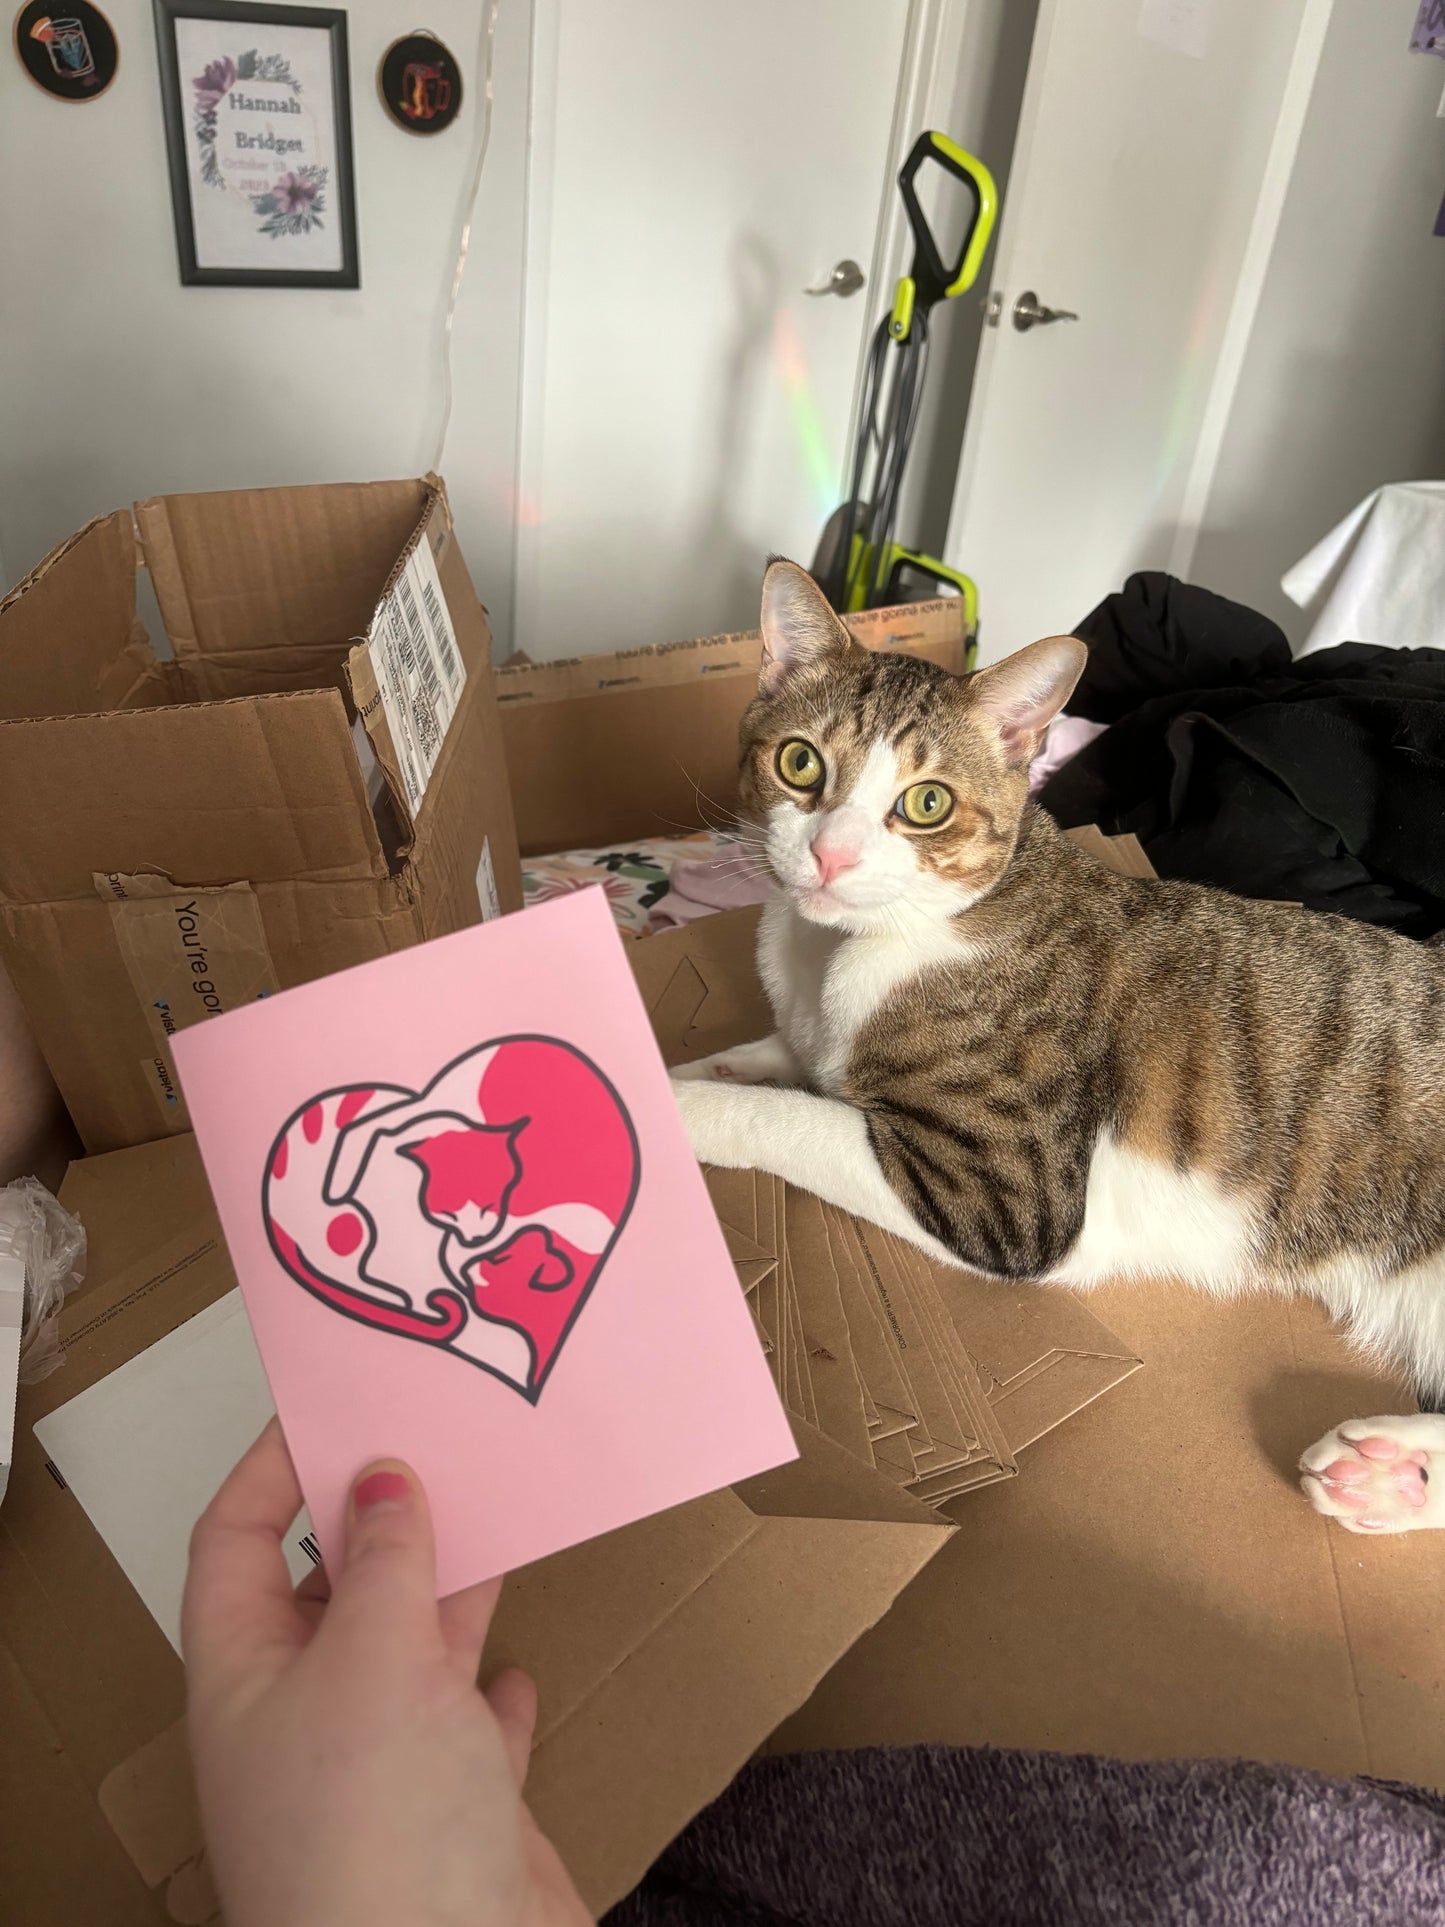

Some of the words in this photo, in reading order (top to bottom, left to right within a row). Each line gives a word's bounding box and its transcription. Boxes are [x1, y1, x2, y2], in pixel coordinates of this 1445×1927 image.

[228, 93, 302, 115] Hannah
[234, 131, 304, 156] Bridget
[175, 901, 208, 974] You're
